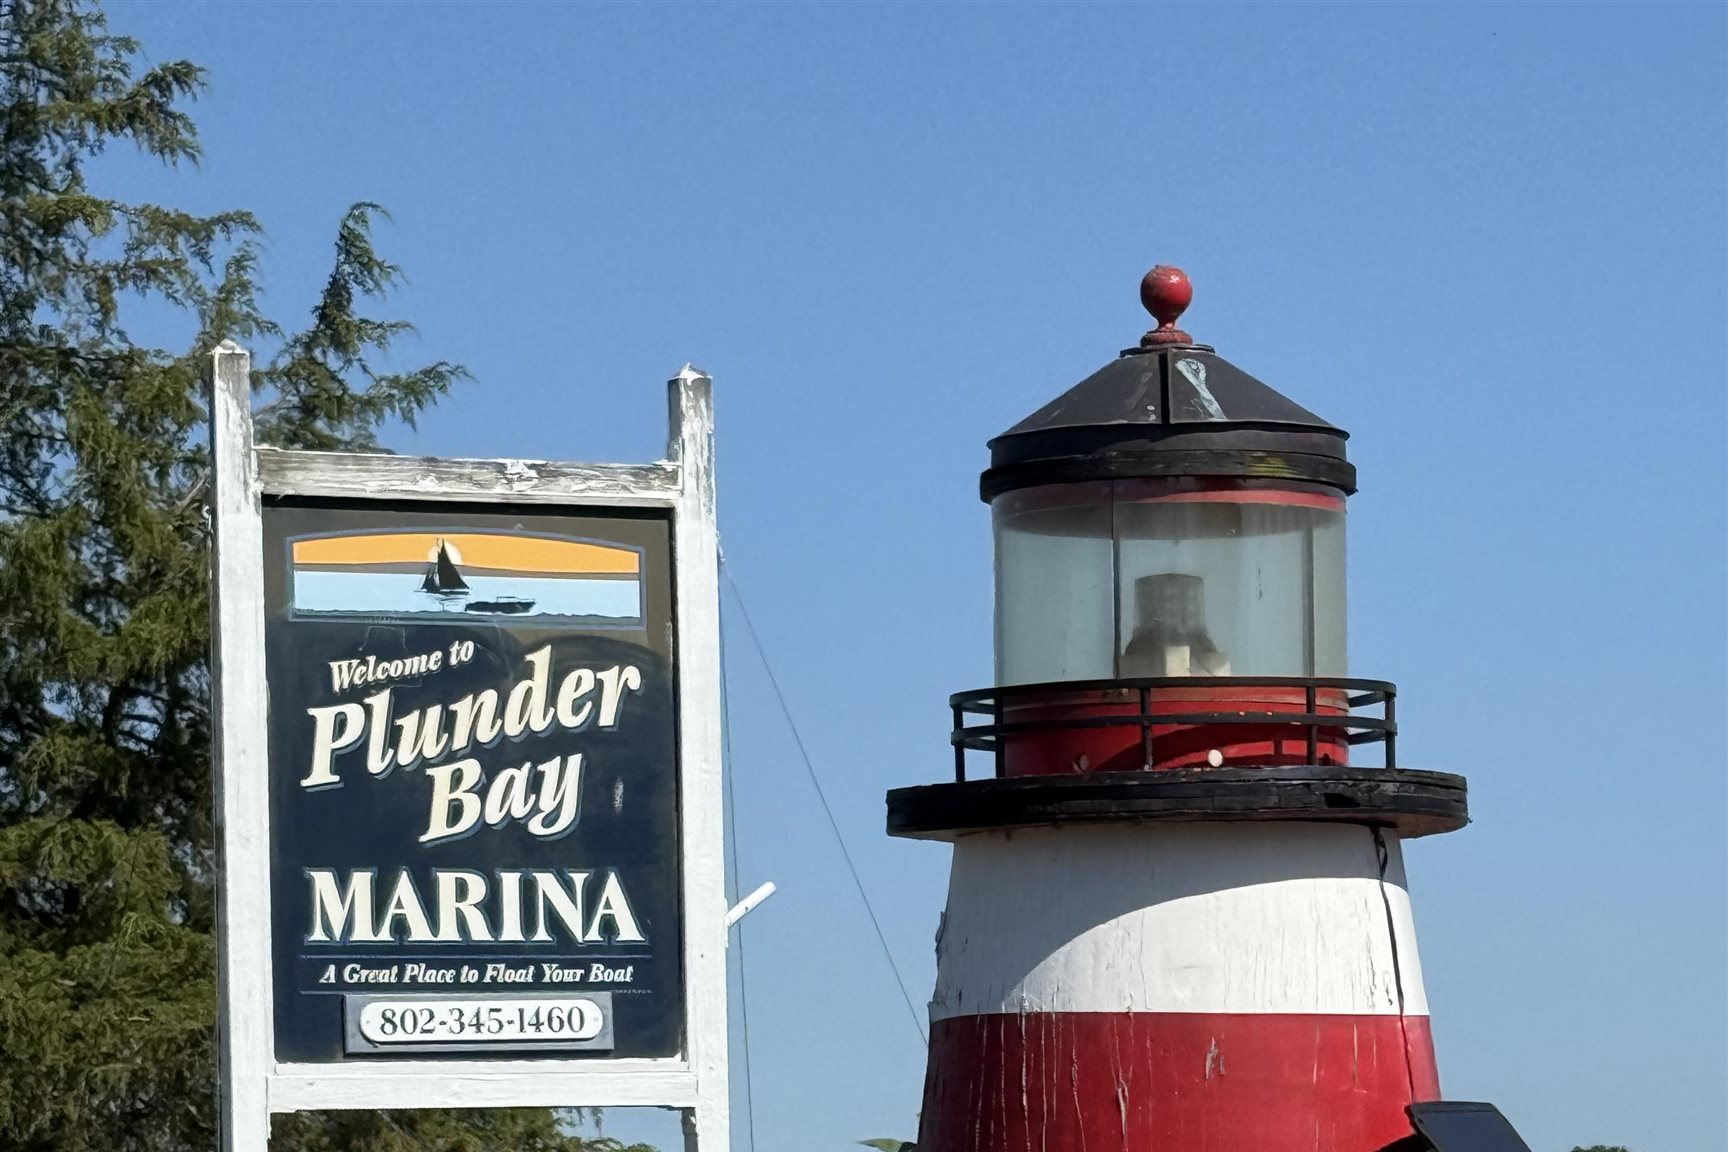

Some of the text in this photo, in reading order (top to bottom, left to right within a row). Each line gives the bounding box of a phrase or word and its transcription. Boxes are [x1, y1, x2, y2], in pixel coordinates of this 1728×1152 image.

[329, 640, 475, 695] Welcome to
[300, 645, 642, 787] Plunder
[418, 753, 583, 843] Bay
[305, 870, 646, 943] MARINA
[319, 965, 336, 983] A
[343, 964, 398, 984] Great
[402, 963, 455, 983] Place
[483, 963, 536, 983] Float
[541, 964, 585, 983] Your
[589, 964, 634, 983] Boat
[379, 1006, 586, 1035] 802-345-1460
